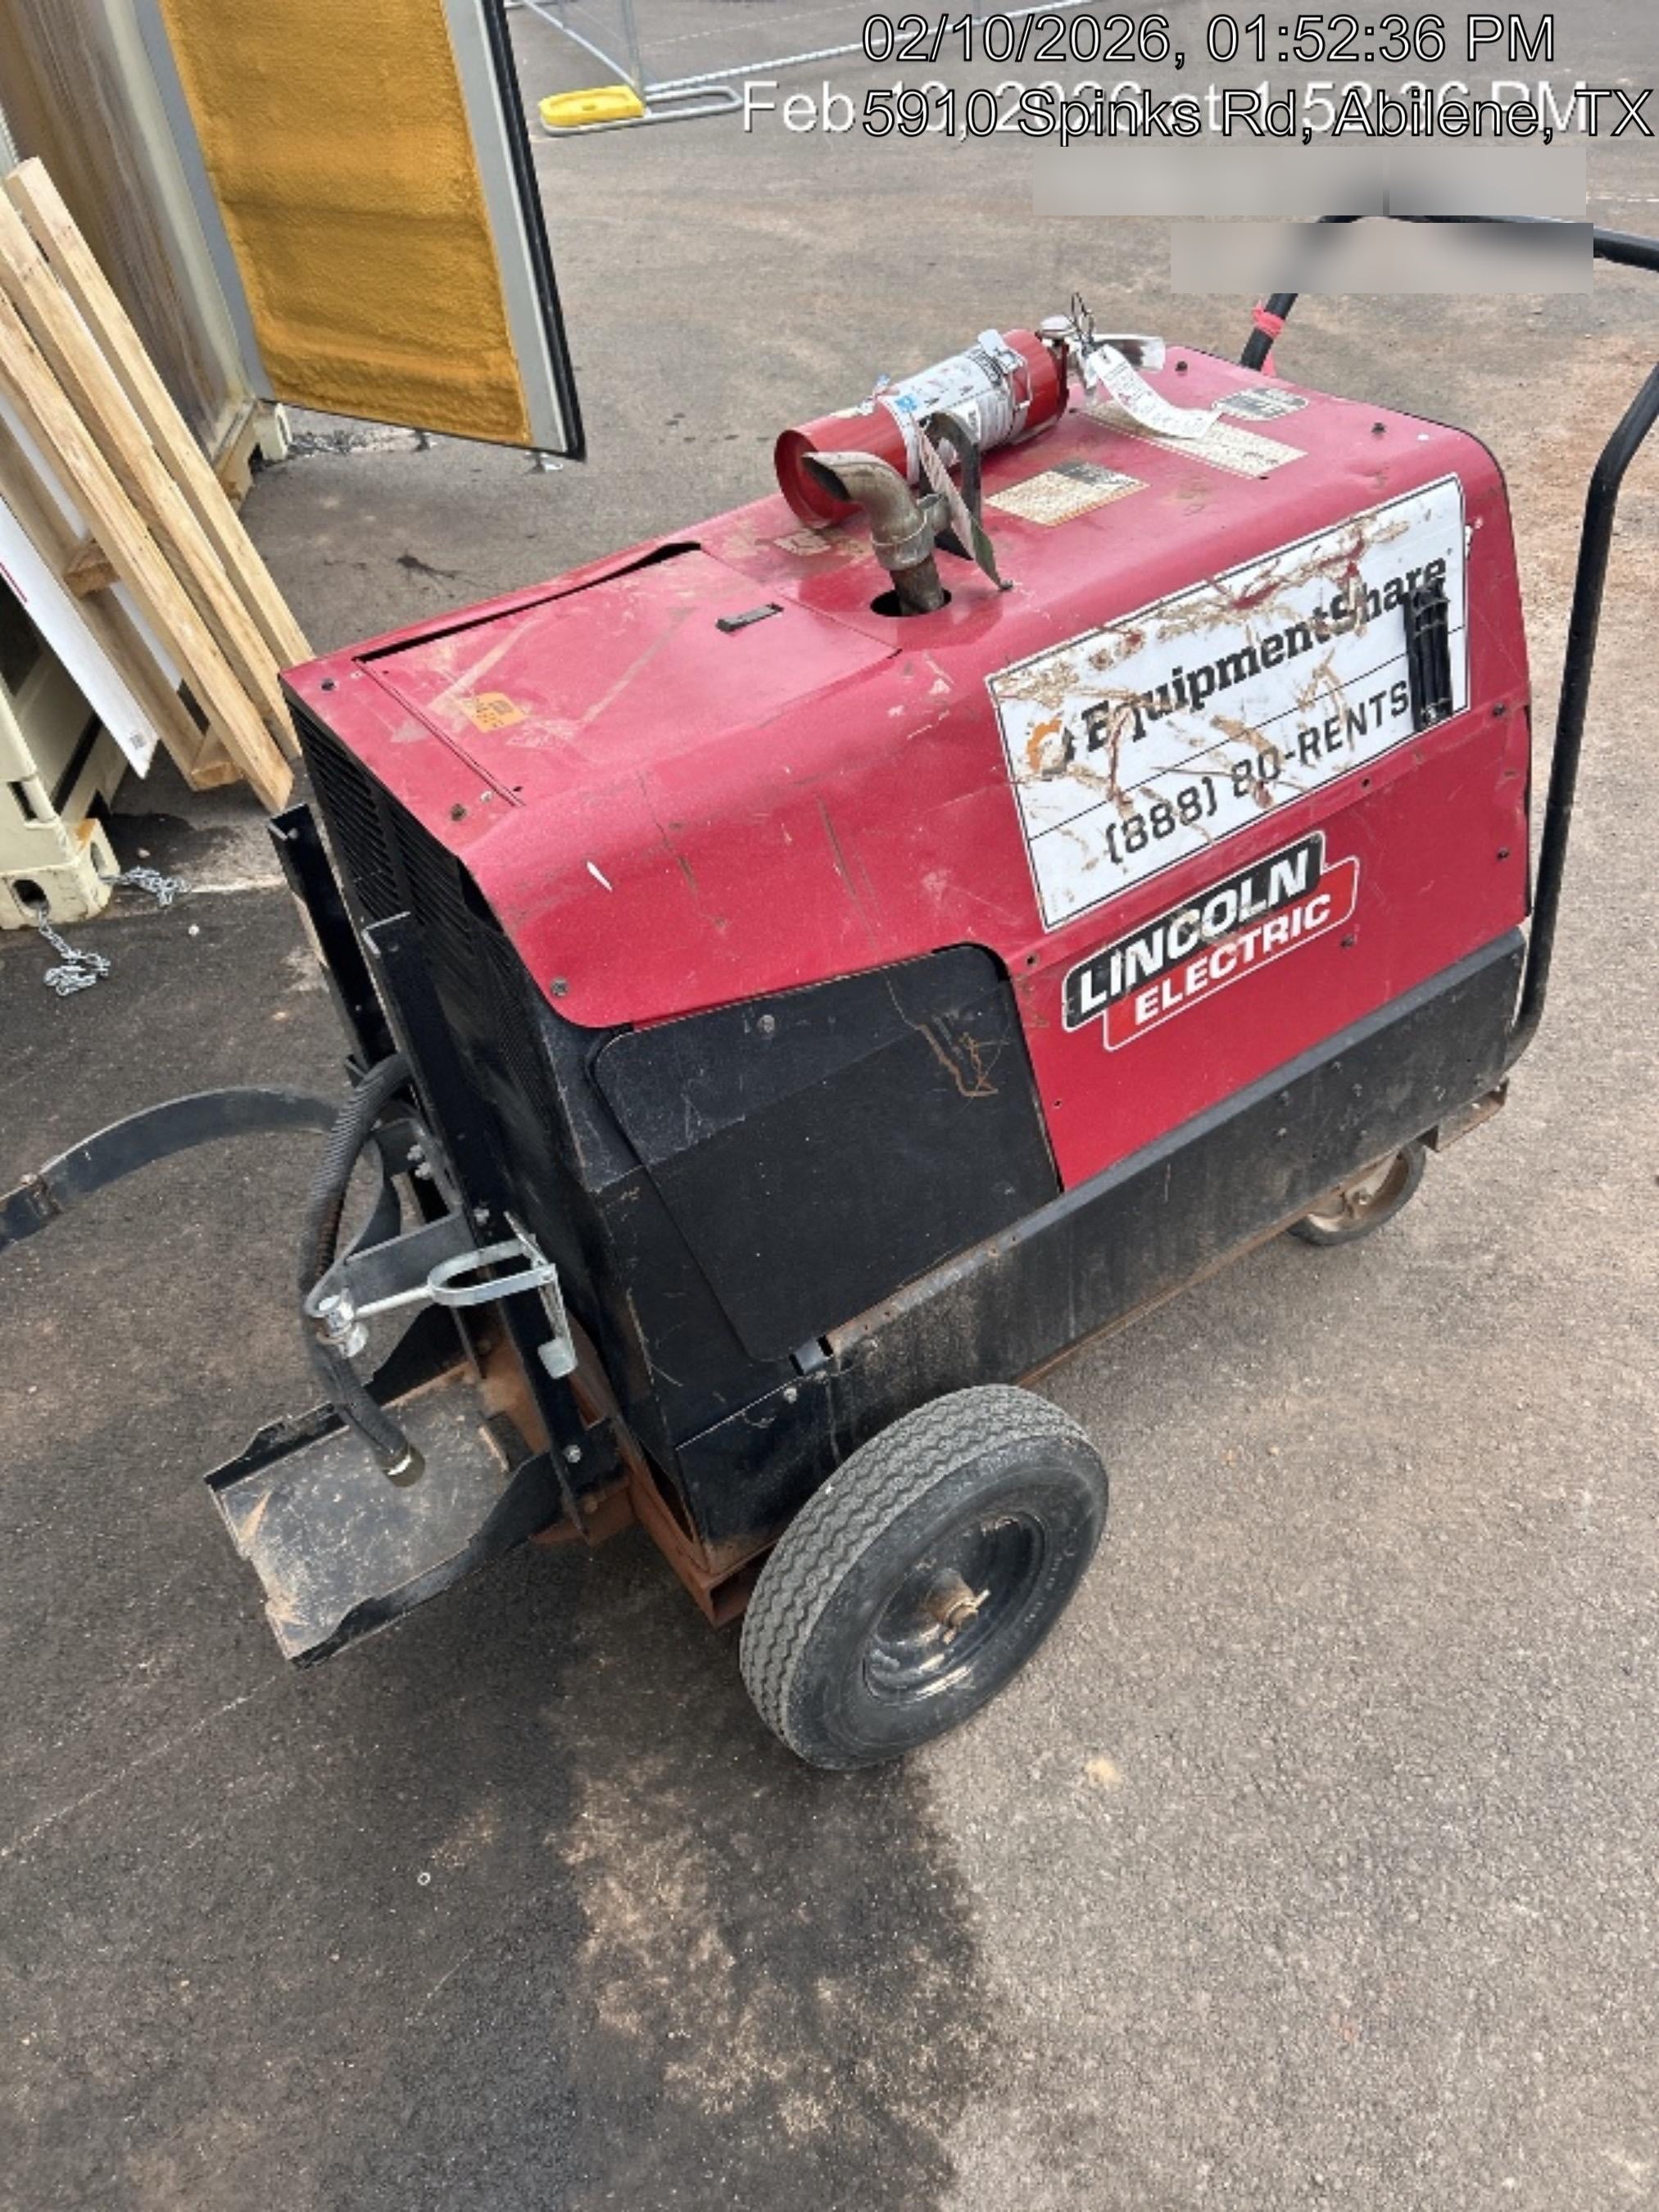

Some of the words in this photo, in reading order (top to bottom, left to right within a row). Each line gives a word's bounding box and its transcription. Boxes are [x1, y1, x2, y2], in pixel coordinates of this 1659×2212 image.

[1105, 776, 1218, 865] (888)
[1231, 681, 1411, 799] 80-RENTS
[1080, 849, 1309, 1015] LINCOLN
[1135, 893, 1331, 1026] ELECTRIC
